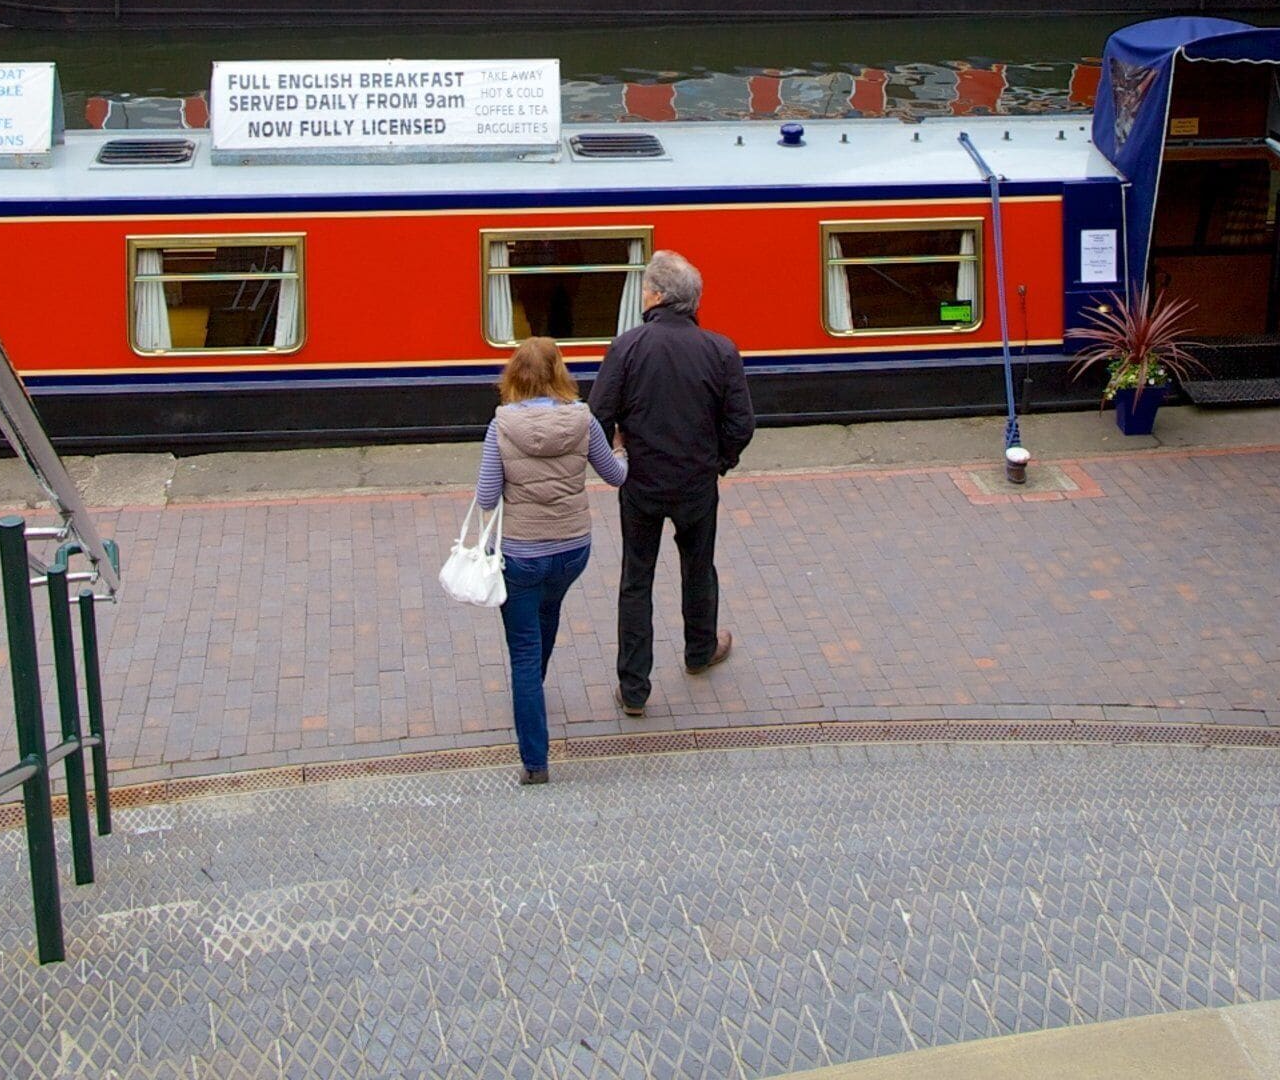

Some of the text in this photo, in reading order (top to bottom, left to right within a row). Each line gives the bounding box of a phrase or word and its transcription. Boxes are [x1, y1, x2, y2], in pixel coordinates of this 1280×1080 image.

[228, 71, 465, 91] FULL ENGLISH BREAKFAST
[480, 70, 544, 81] TAKE AWAY
[480, 87, 545, 98] HOT & COLD
[229, 92, 466, 112] SERVED DAILY FROM 9am
[475, 104, 549, 116] COFFEE & TEA
[248, 118, 447, 138] NOW FULLY LICENSED
